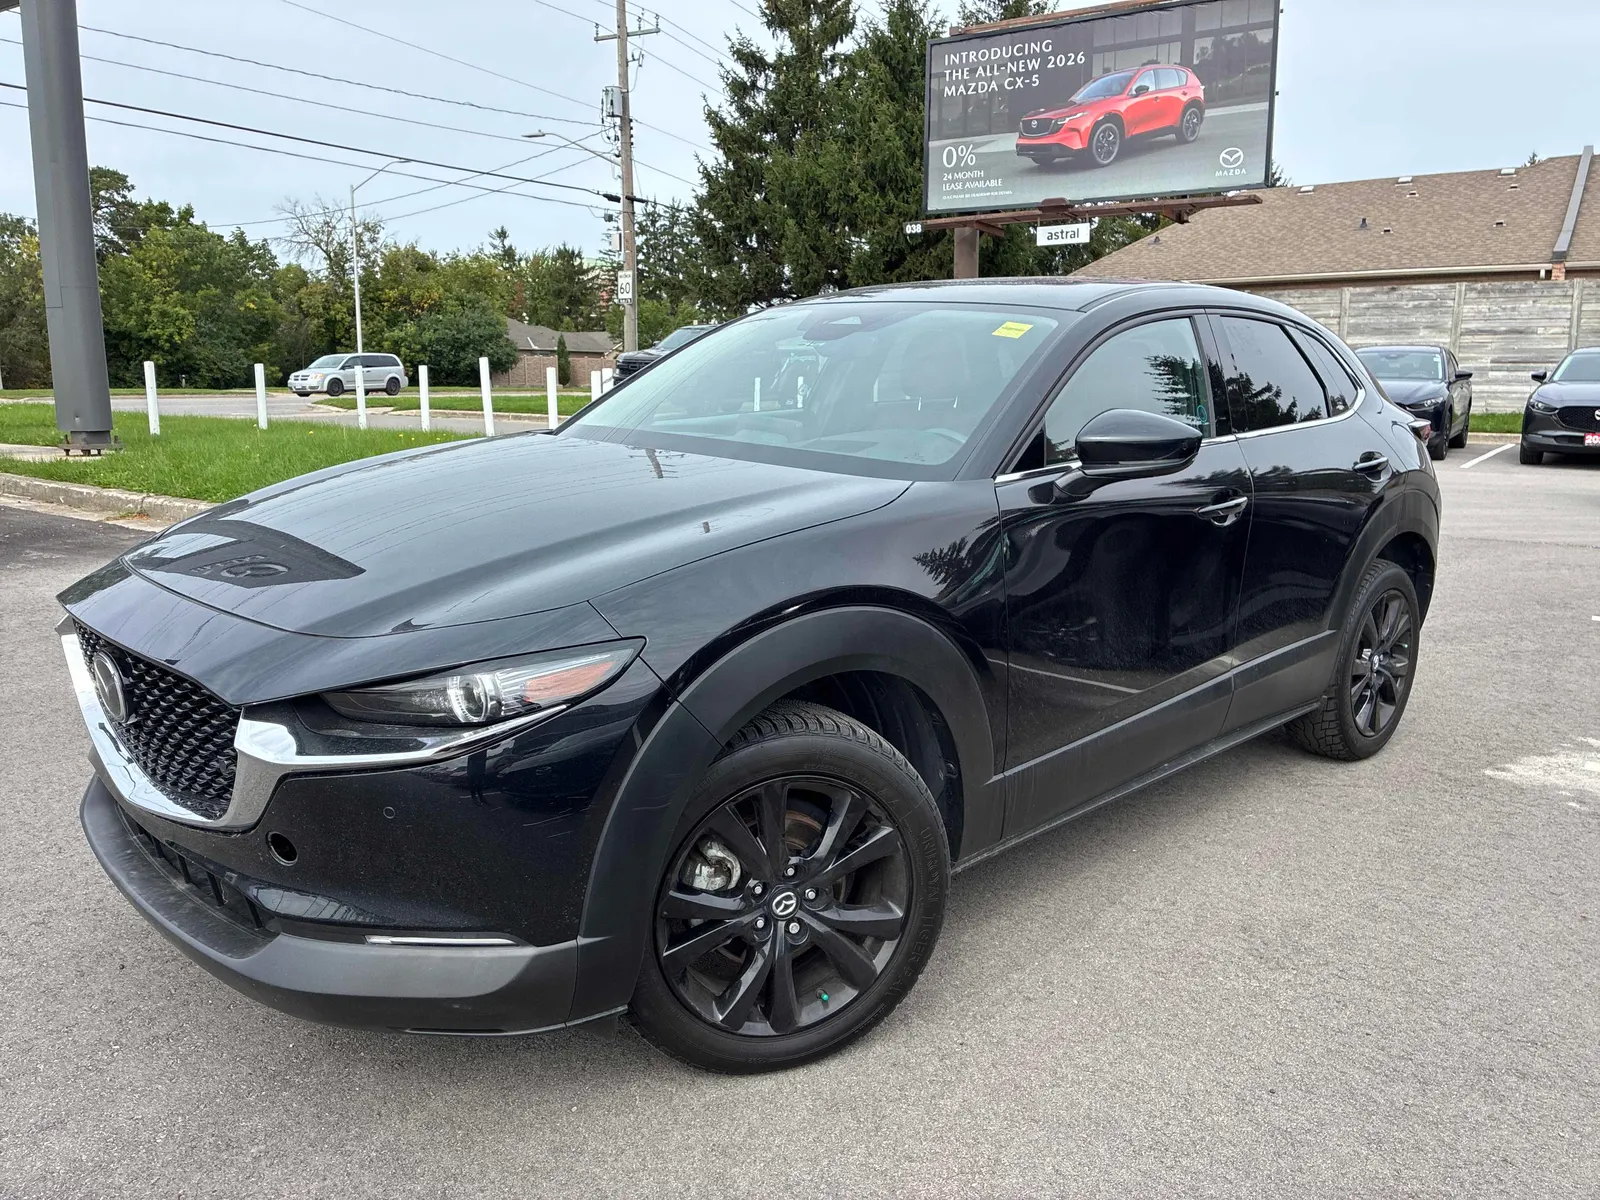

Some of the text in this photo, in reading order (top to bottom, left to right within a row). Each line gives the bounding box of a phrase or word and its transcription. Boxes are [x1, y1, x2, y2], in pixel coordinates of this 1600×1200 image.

[945, 40, 1053, 66] INTRODUCING
[944, 51, 1085, 82] THE ALL-NEW 2026
[944, 74, 1040, 97] MAZDA CX-5
[942, 144, 976, 168] 0%
[943, 170, 984, 181] 24 MONTH
[1215, 168, 1246, 177] MAZDA
[942, 179, 1003, 191] LEASE AVAILABLE
[906, 224, 922, 234] 038
[1046, 228, 1080, 241] astral
[619, 282, 631, 294] 60
[920, 827, 940, 902] UNIROYAL
